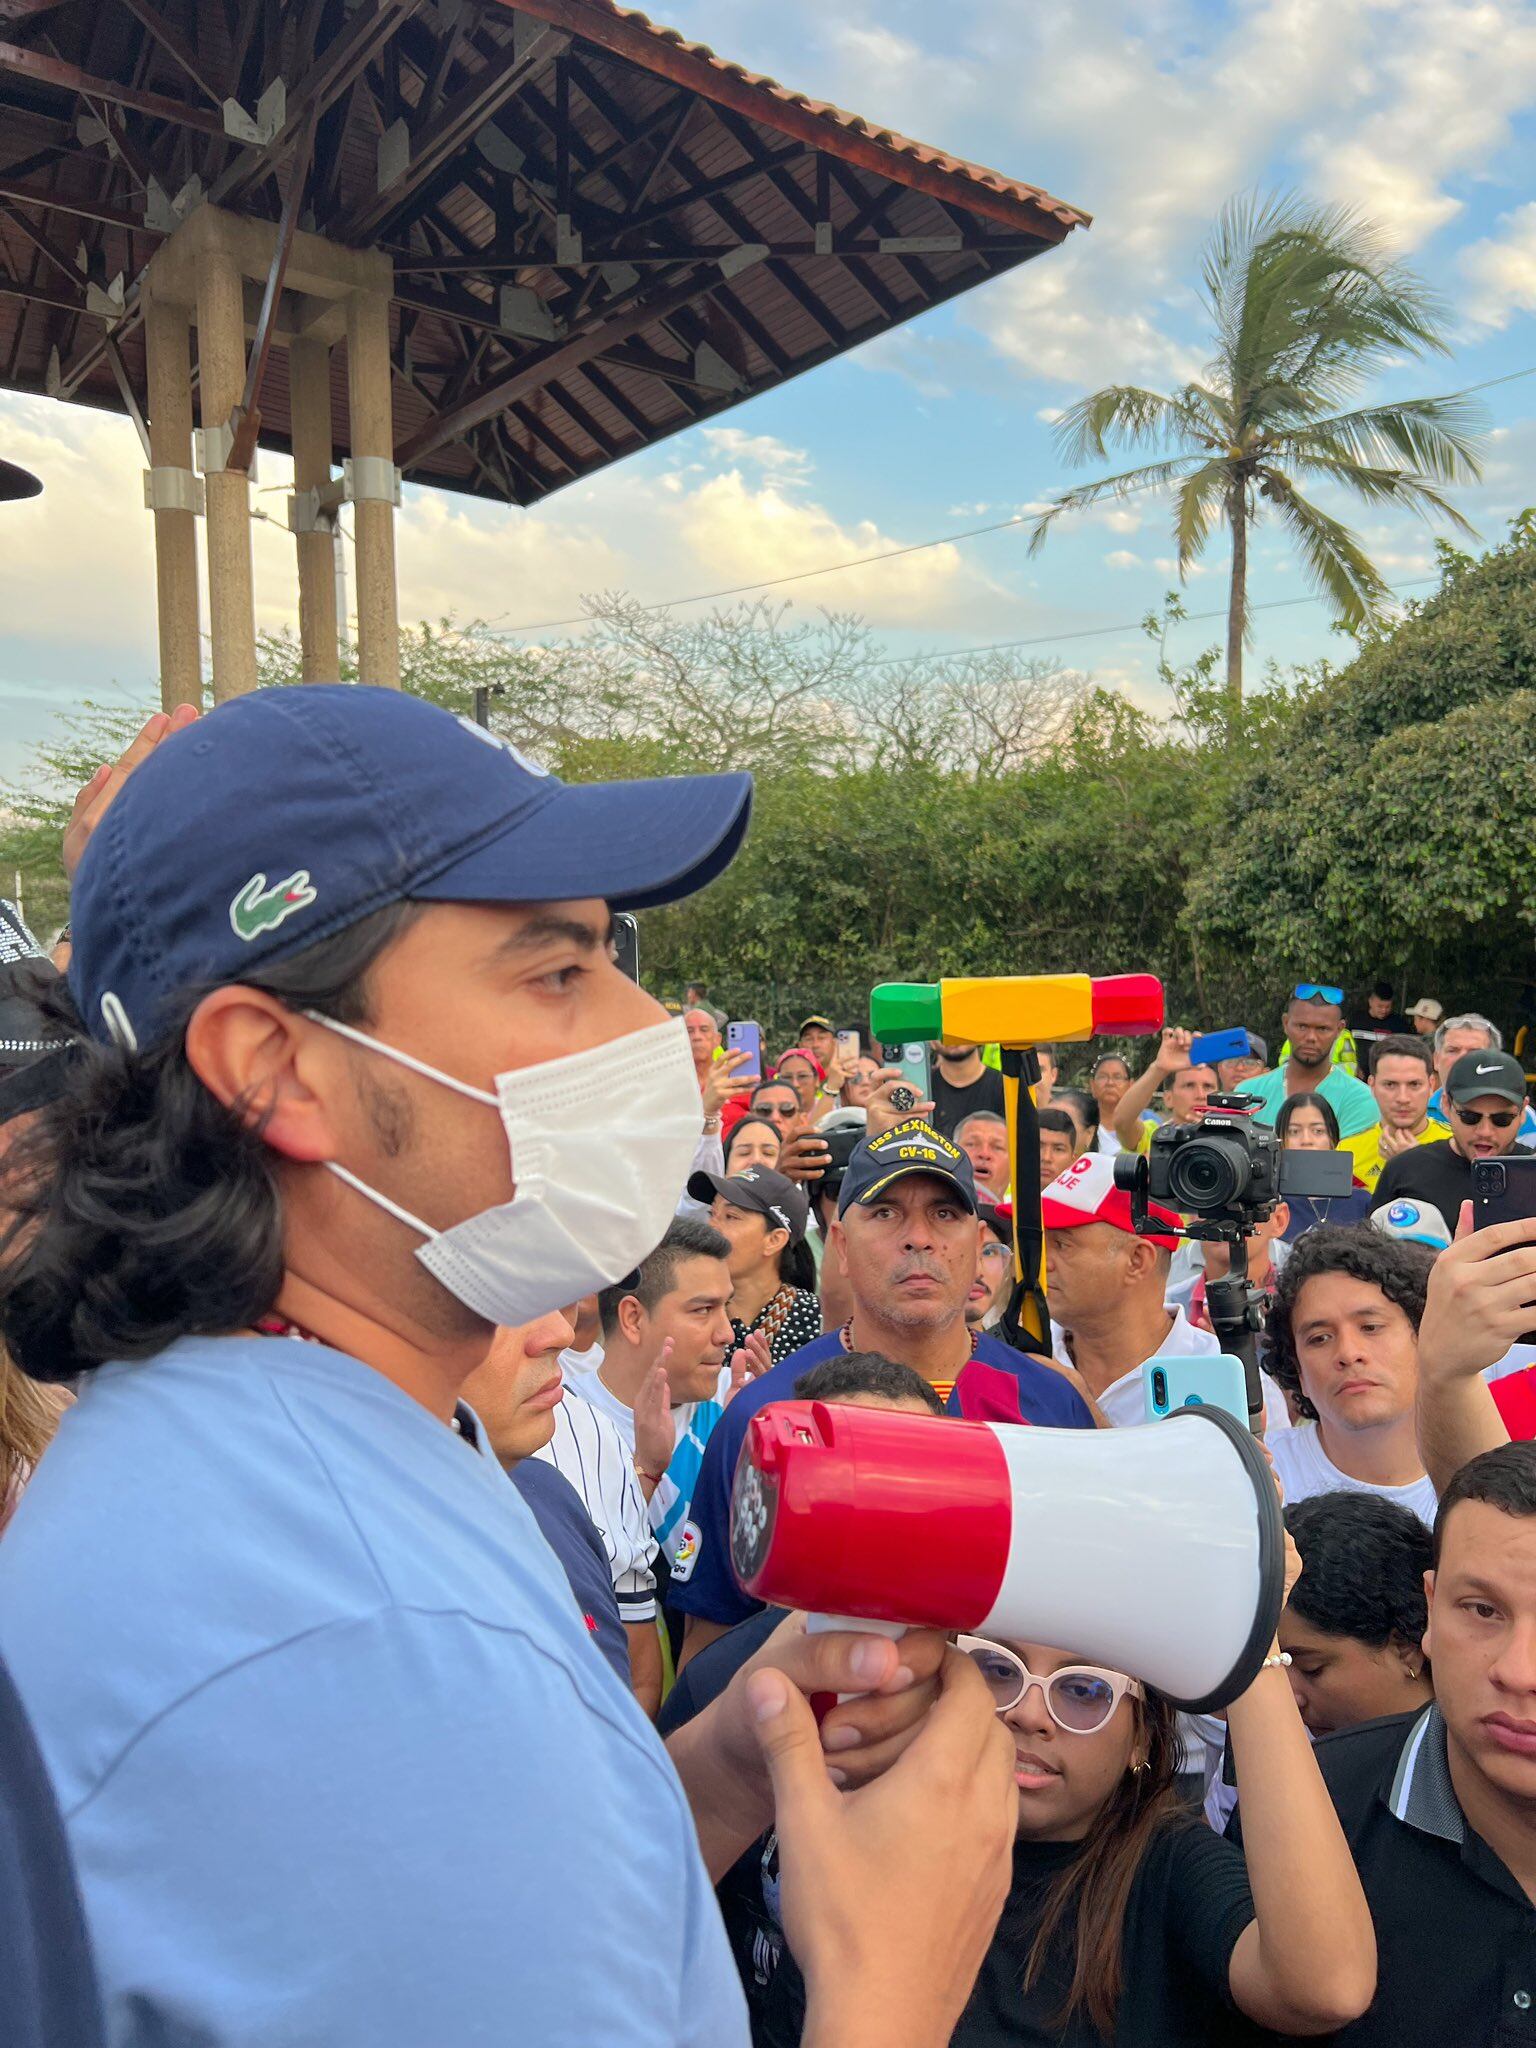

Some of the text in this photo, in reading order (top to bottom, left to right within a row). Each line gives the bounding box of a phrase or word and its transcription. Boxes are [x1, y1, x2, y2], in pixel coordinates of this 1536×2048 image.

[1204, 1118, 1231, 1126] Canon
[867, 1119, 961, 1159] USS LEXINGTON
[899, 1146, 937, 1160] CV-16
